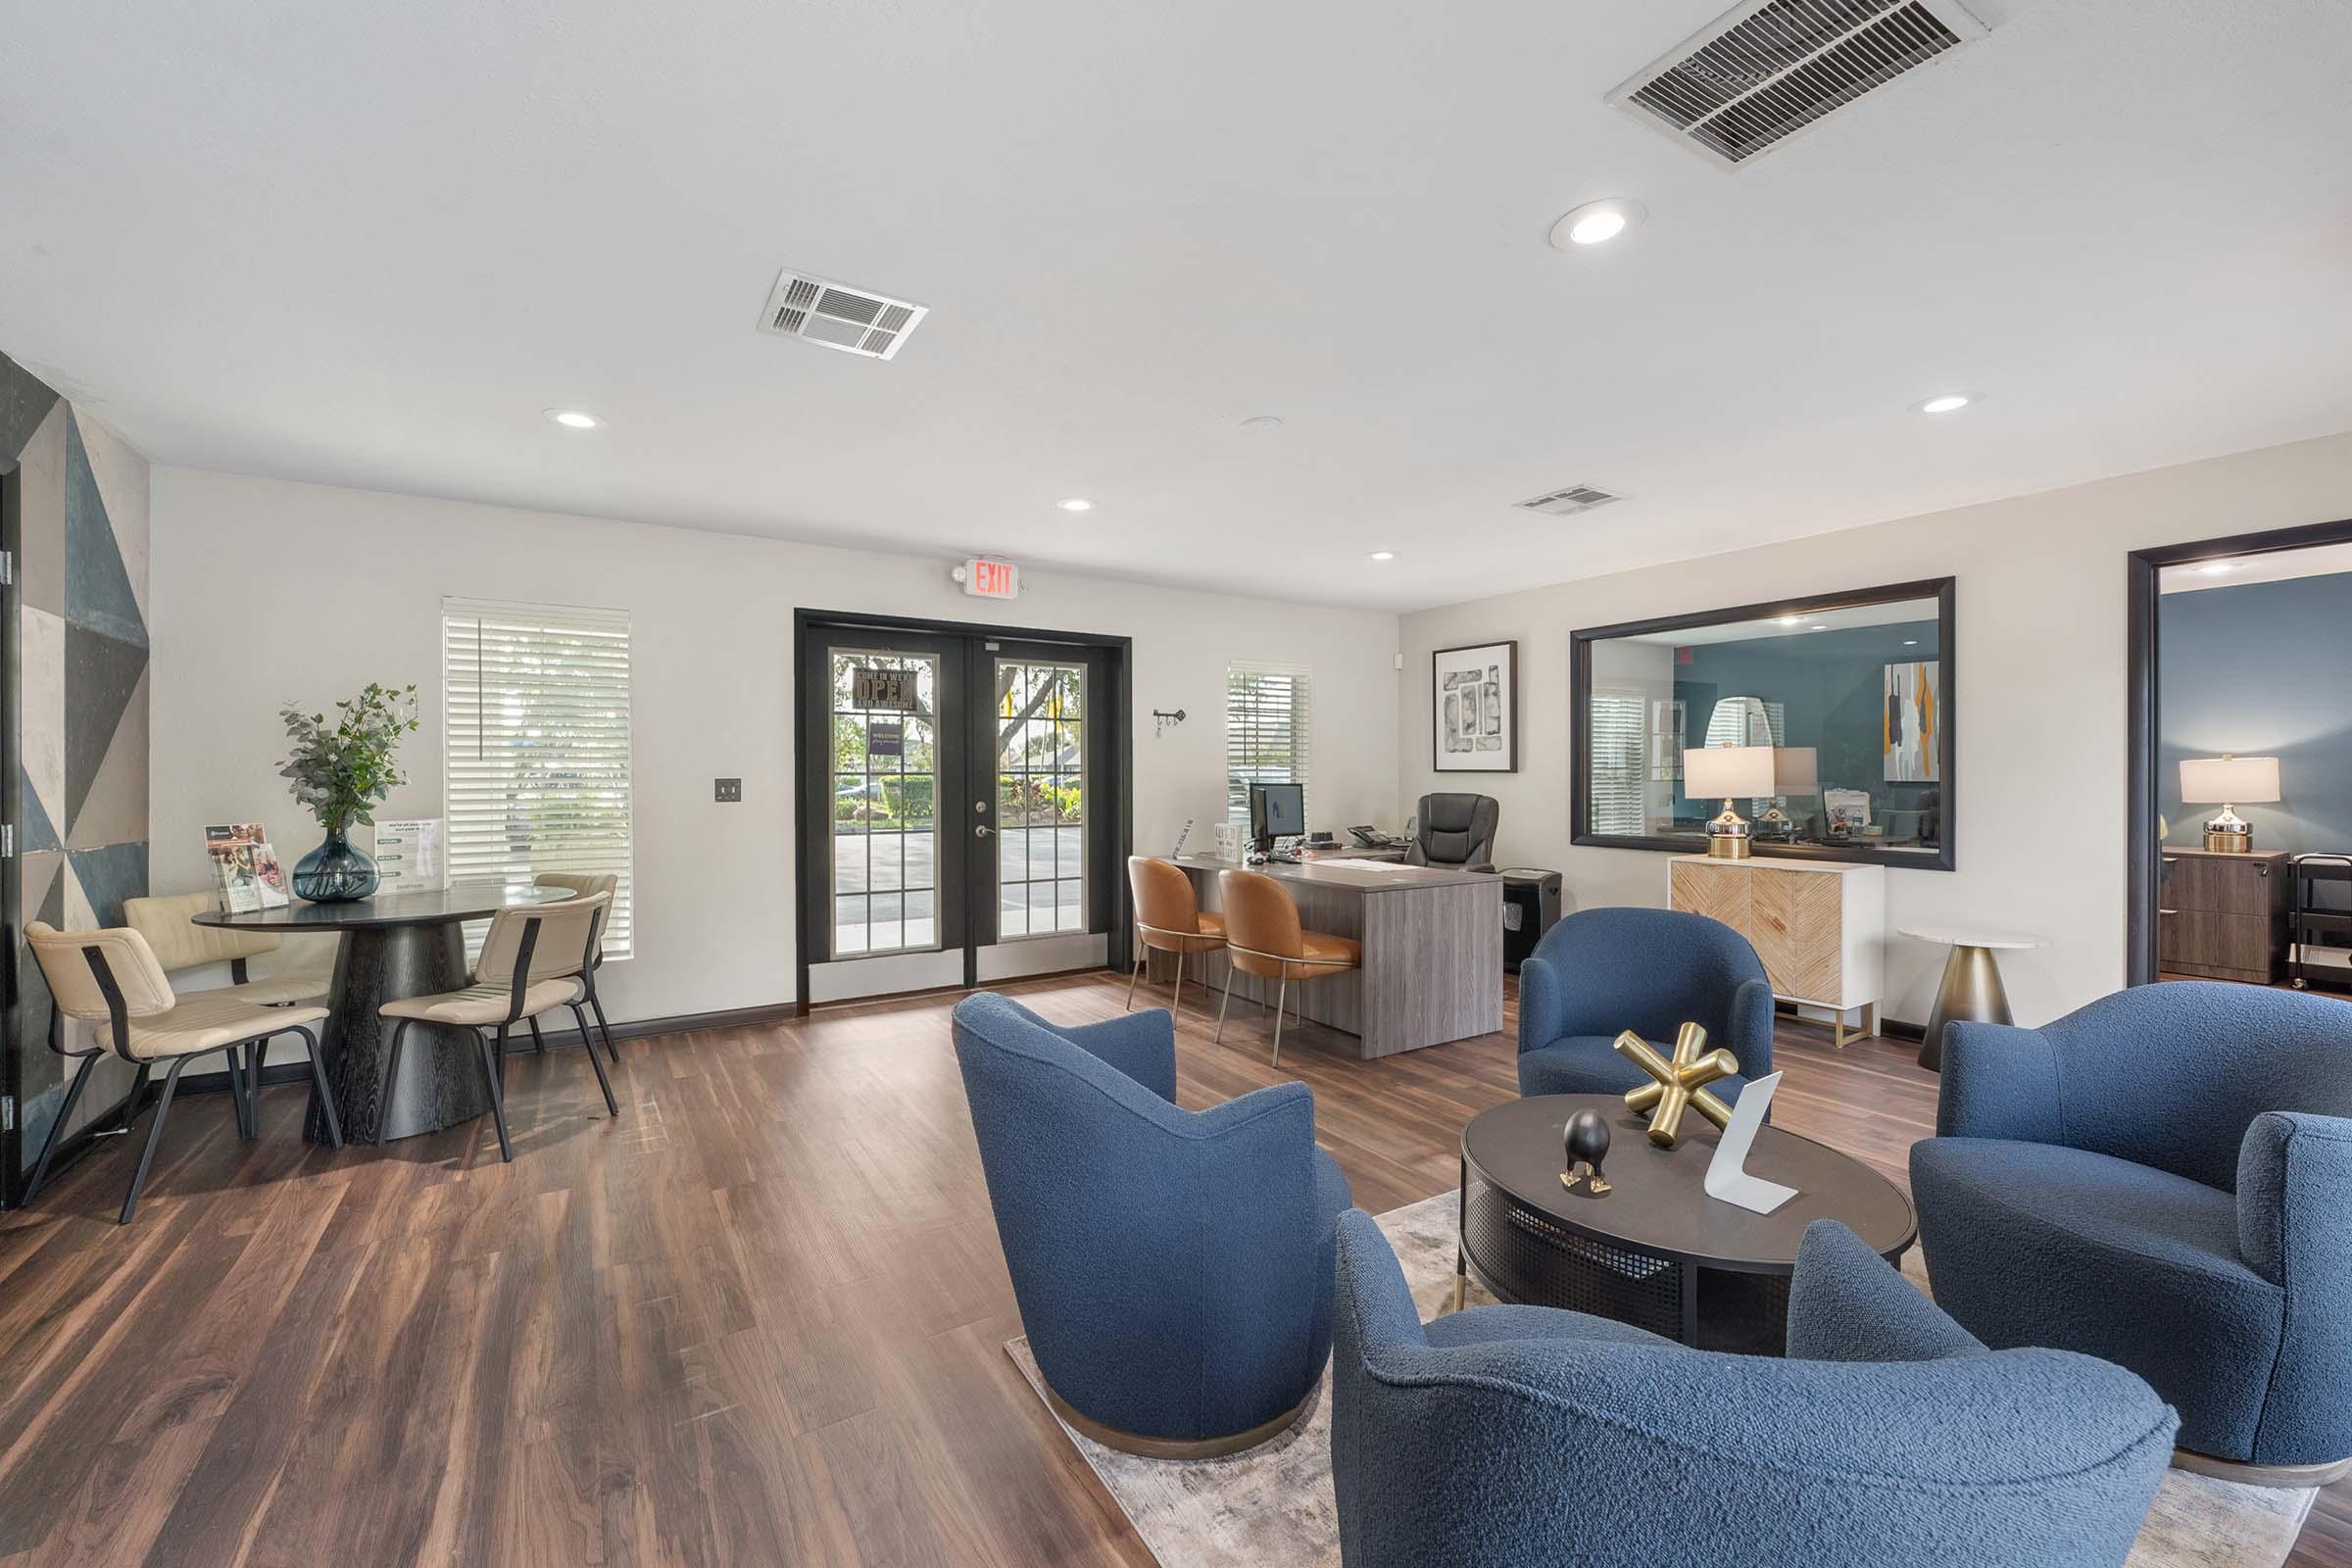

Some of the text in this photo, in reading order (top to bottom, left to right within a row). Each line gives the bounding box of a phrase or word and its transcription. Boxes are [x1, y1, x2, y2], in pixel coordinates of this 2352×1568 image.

[975, 561, 1011, 596] EXIT
[857, 670, 878, 680] COME
[879, 672, 888, 681] IN
[857, 679, 912, 701] OPEN
[875, 700, 914, 710] AWESOME
